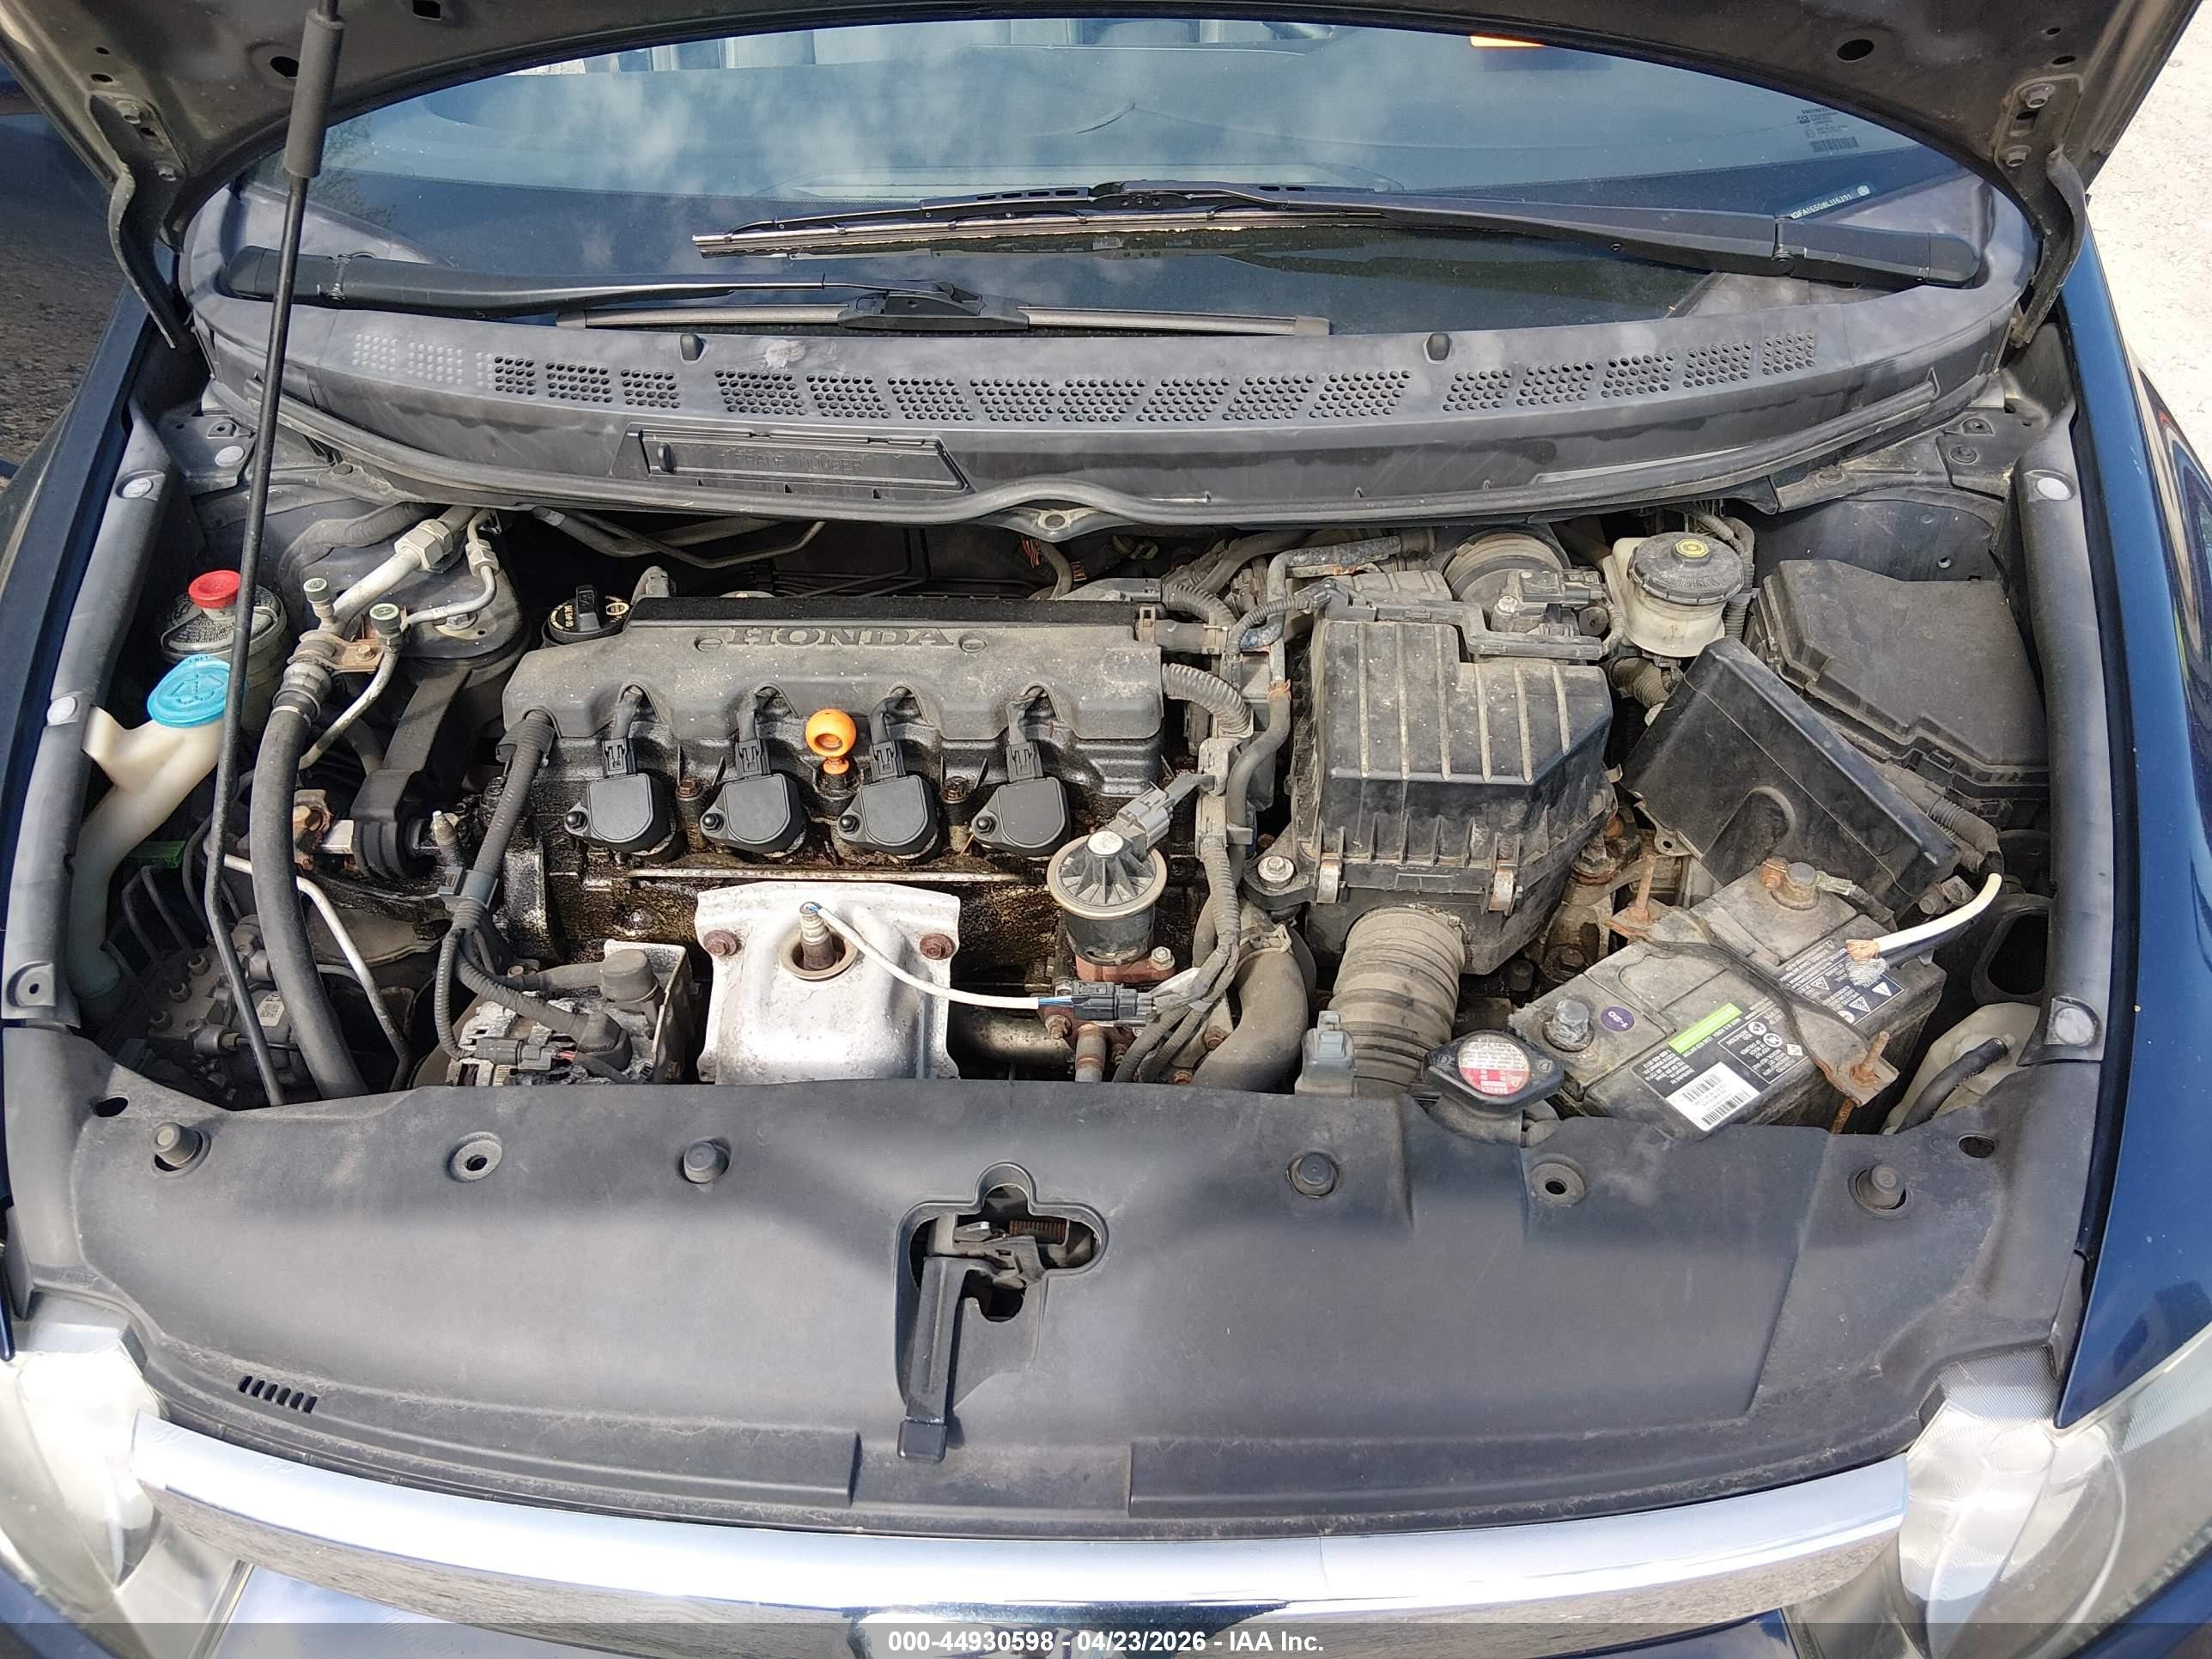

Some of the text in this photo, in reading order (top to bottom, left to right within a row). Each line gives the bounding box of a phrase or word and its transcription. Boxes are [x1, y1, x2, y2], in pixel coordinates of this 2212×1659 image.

[733, 452, 862, 471] FRAME NUMBER
[727, 627, 954, 646] HONDA
